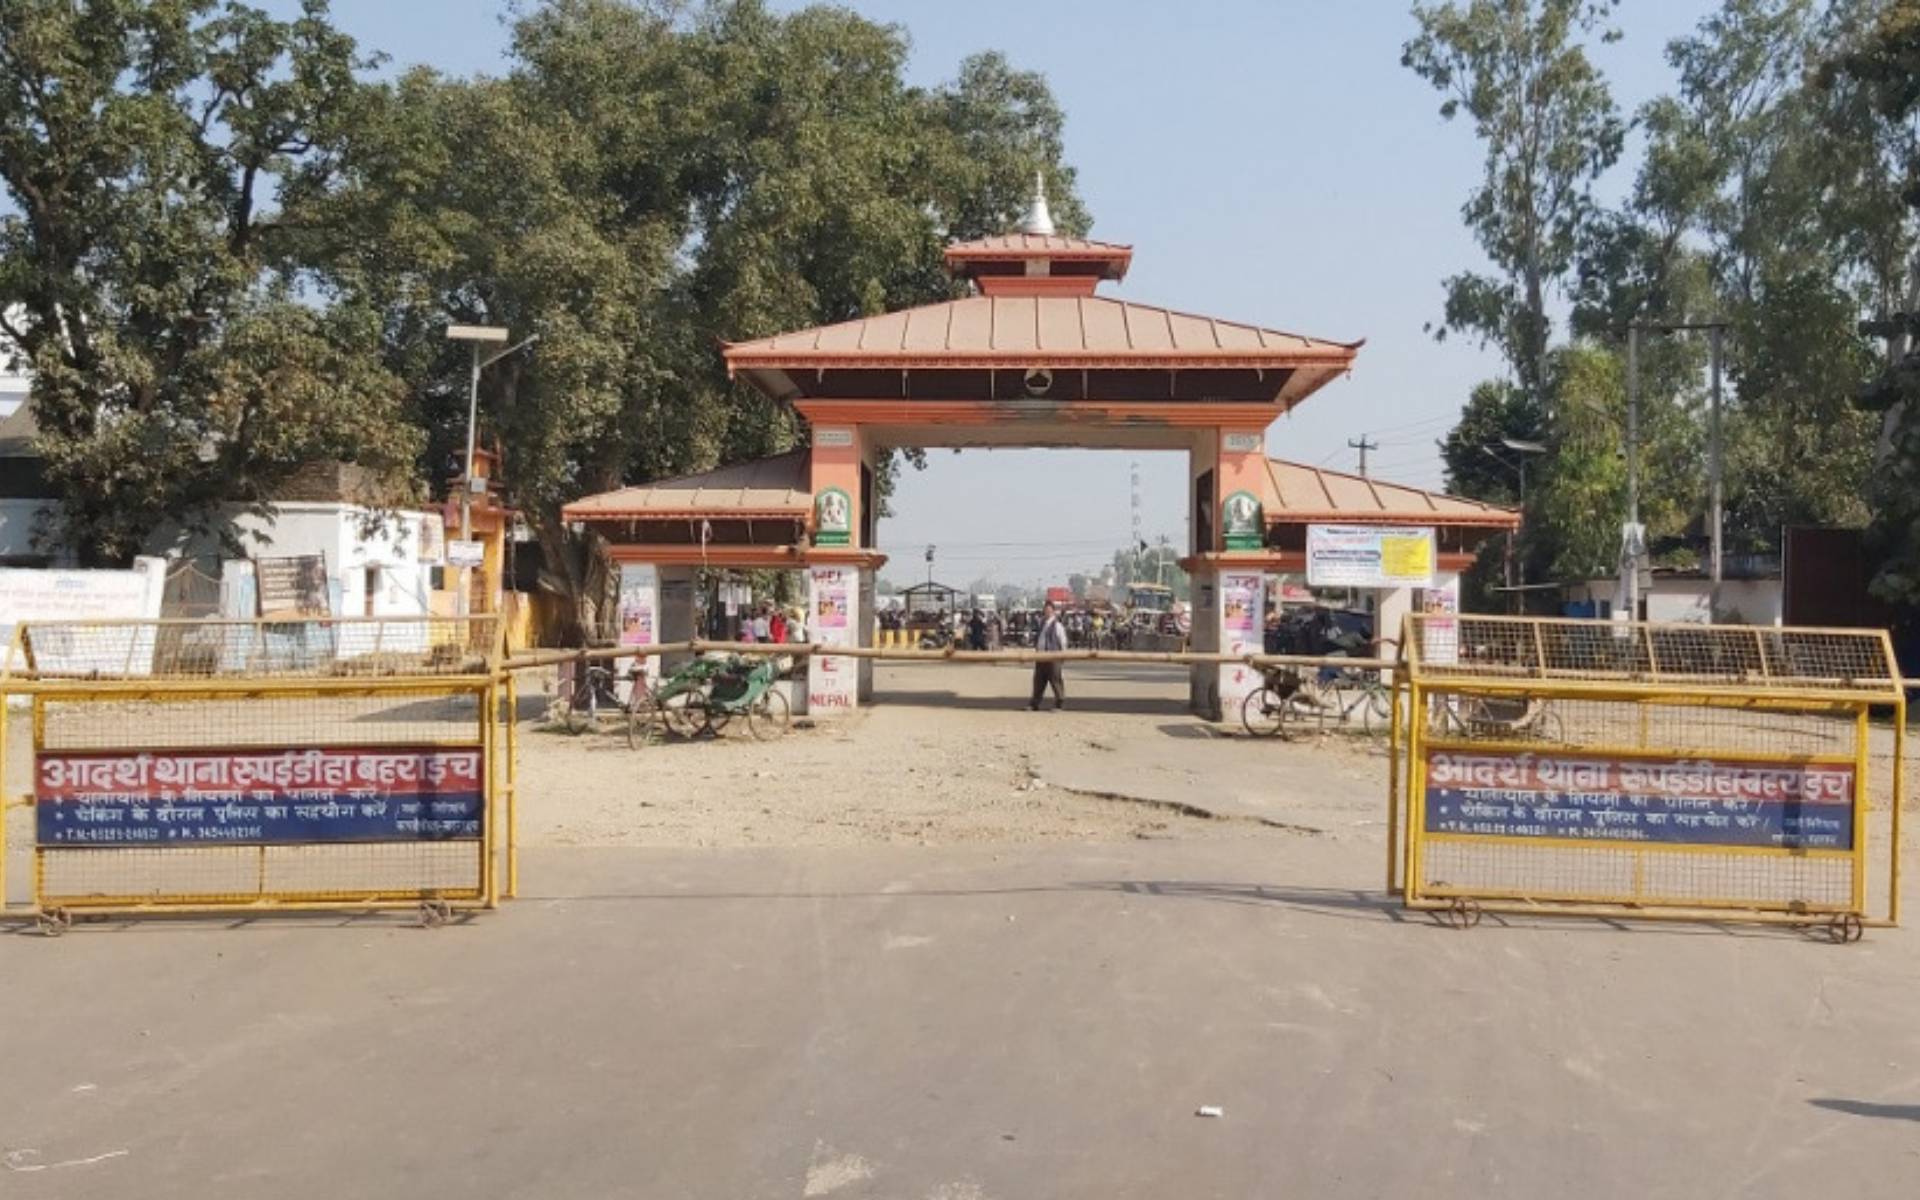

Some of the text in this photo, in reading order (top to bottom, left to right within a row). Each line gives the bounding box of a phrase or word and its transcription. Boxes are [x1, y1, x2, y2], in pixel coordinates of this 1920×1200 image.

[810, 693, 850, 707] NEPAL
[42, 754, 151, 789] आदर्श
[154, 756, 231, 785] थाना
[357, 752, 481, 786] बहराइच
[1430, 753, 1534, 787] आदर्श
[1536, 757, 1611, 789] थाना
[264, 805, 288, 819] का
[1645, 812, 1668, 825] का
